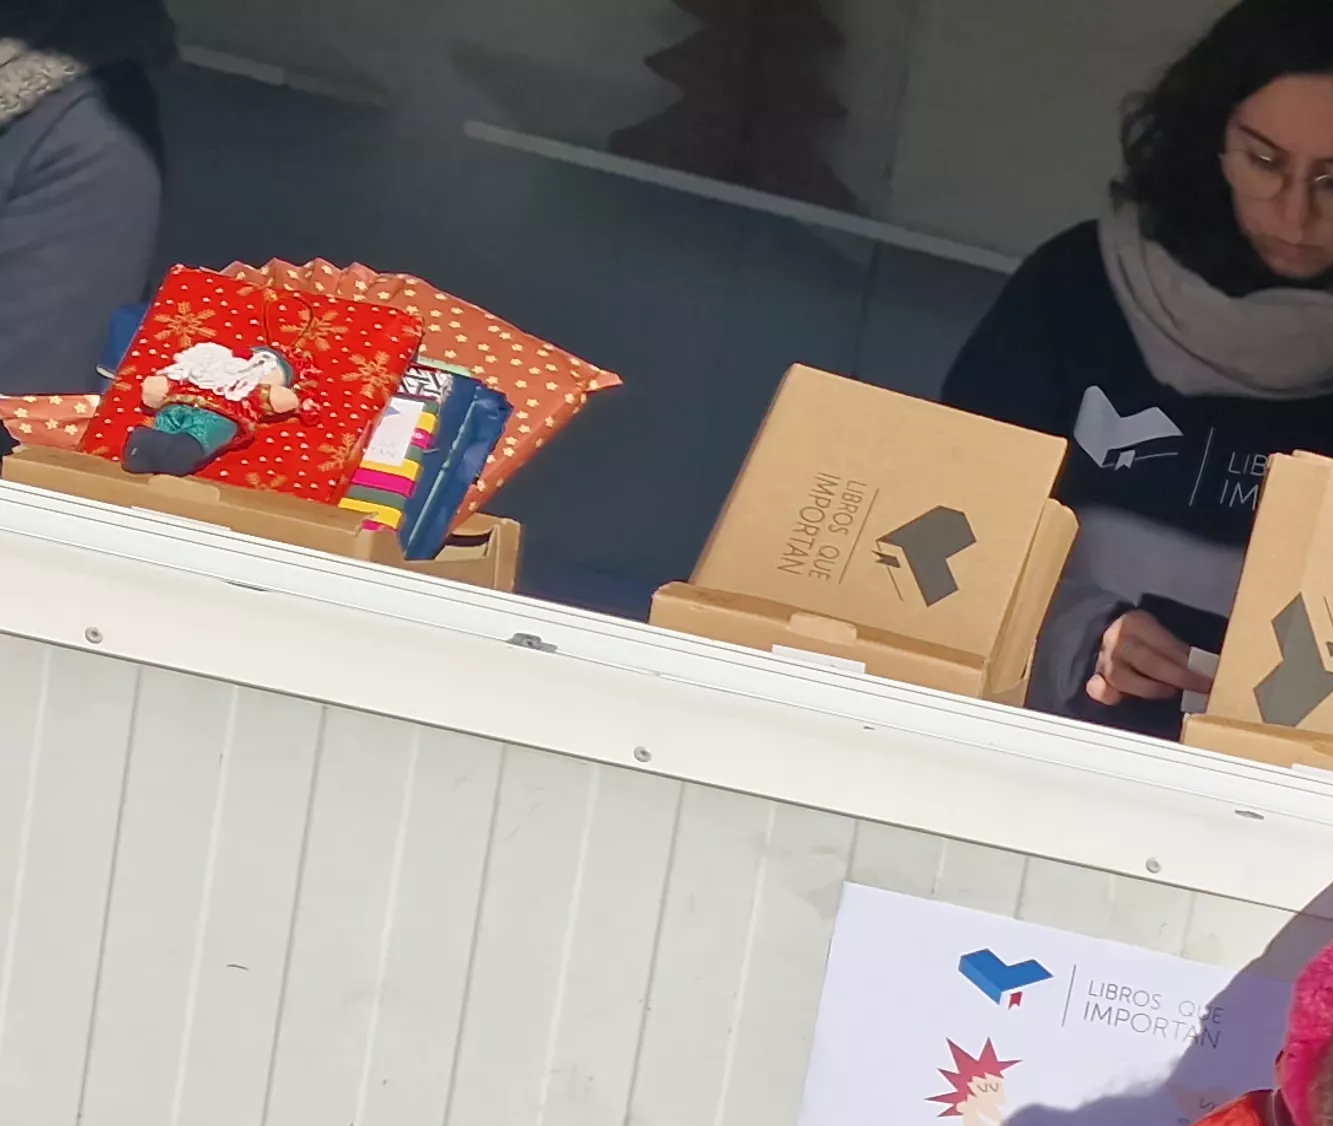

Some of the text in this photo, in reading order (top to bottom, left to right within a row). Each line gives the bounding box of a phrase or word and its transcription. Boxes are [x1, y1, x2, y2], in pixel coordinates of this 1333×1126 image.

[1228, 451, 1268, 477] LIB
[776, 471, 842, 576] IMPORTAN
[808, 480, 868, 581] LIBROS QUE
[1083, 1001, 1222, 1050] IMPORTAN
[1088, 980, 1225, 1024] LIBROS QUE
